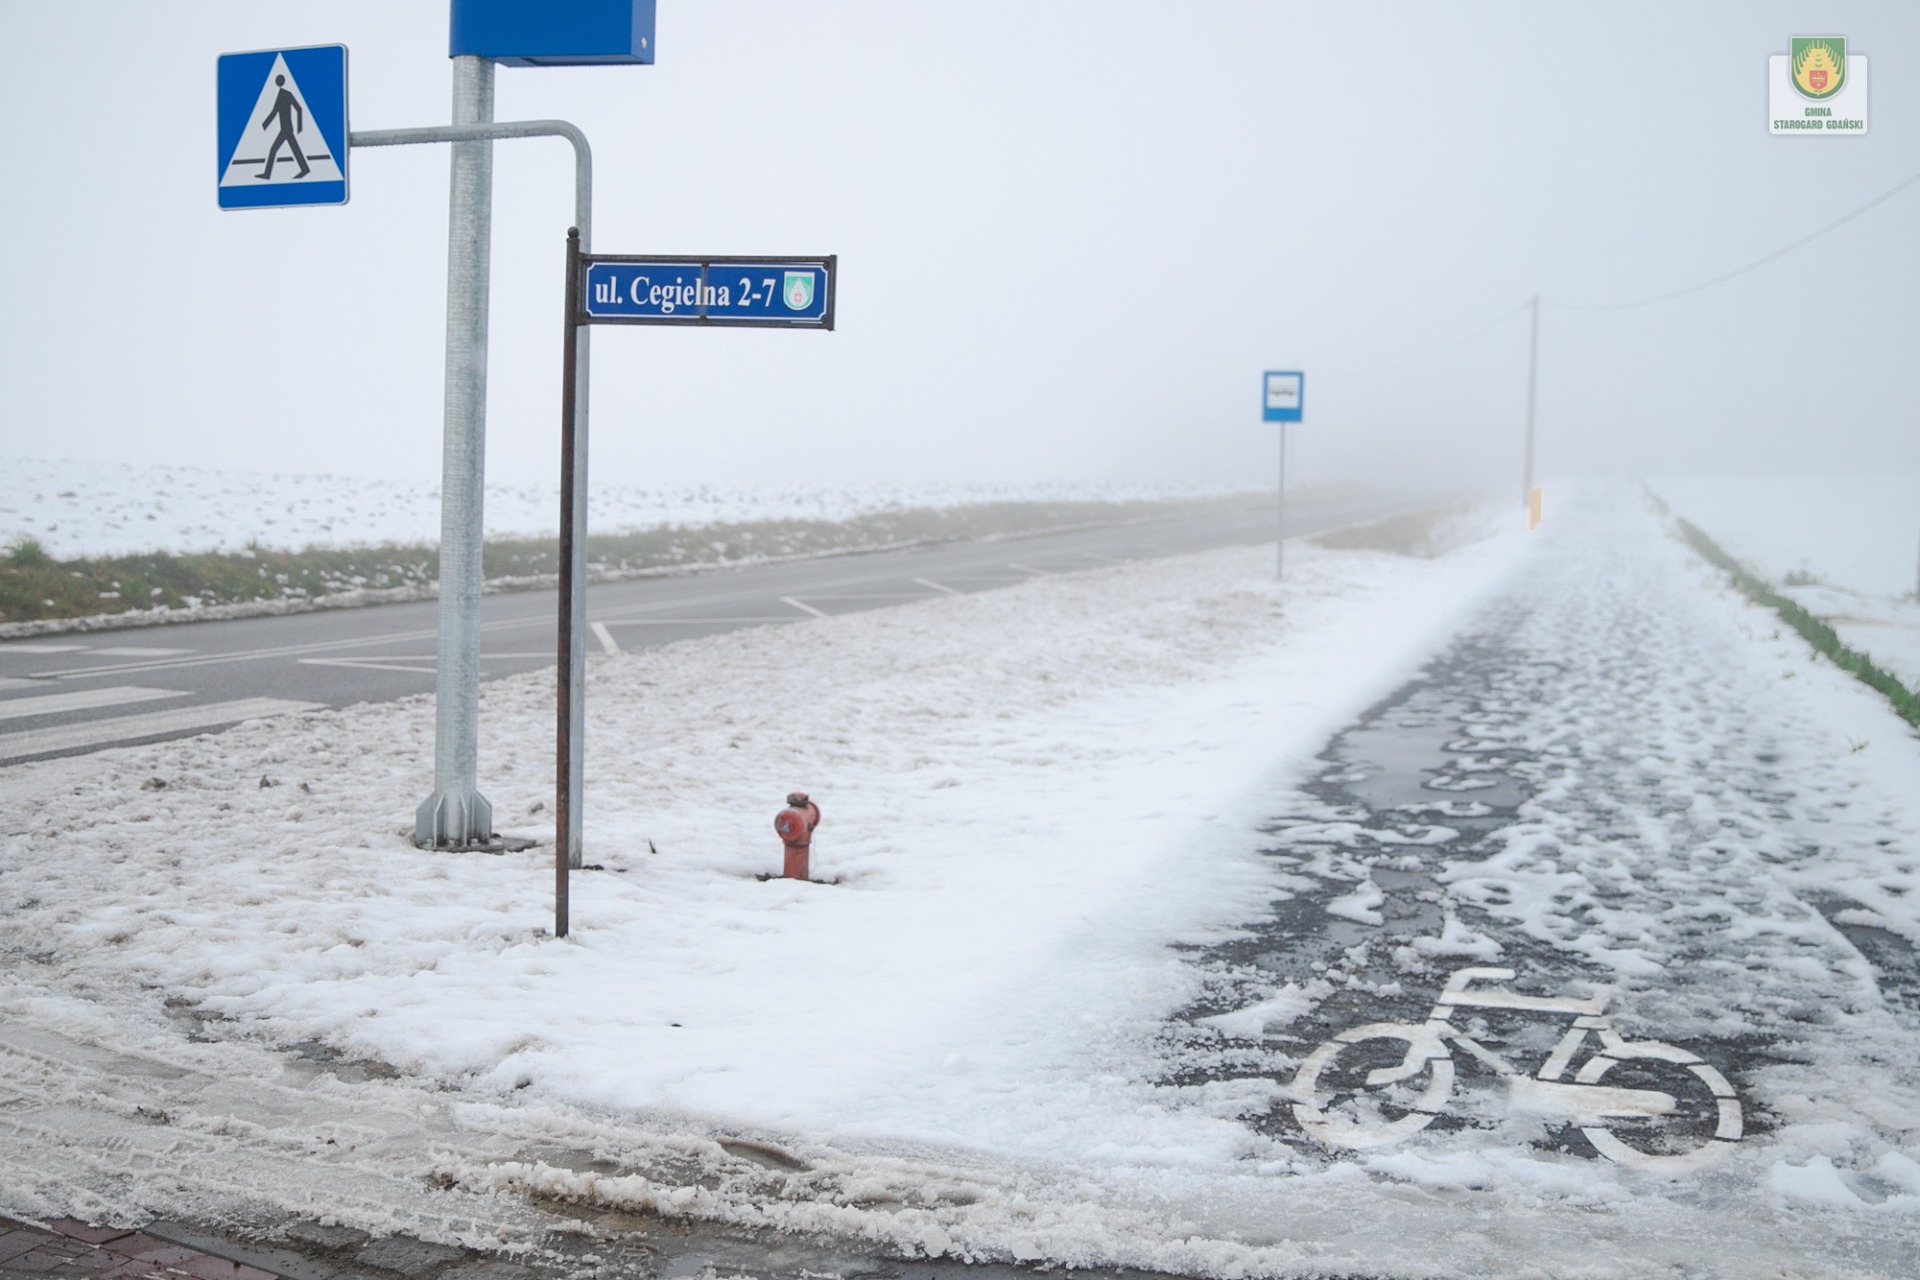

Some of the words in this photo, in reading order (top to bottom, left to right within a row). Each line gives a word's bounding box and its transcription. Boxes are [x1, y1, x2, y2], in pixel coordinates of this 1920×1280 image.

[595, 276, 623, 305] ul.
[630, 276, 731, 314] Cegielna
[737, 277, 777, 308] 2-7
